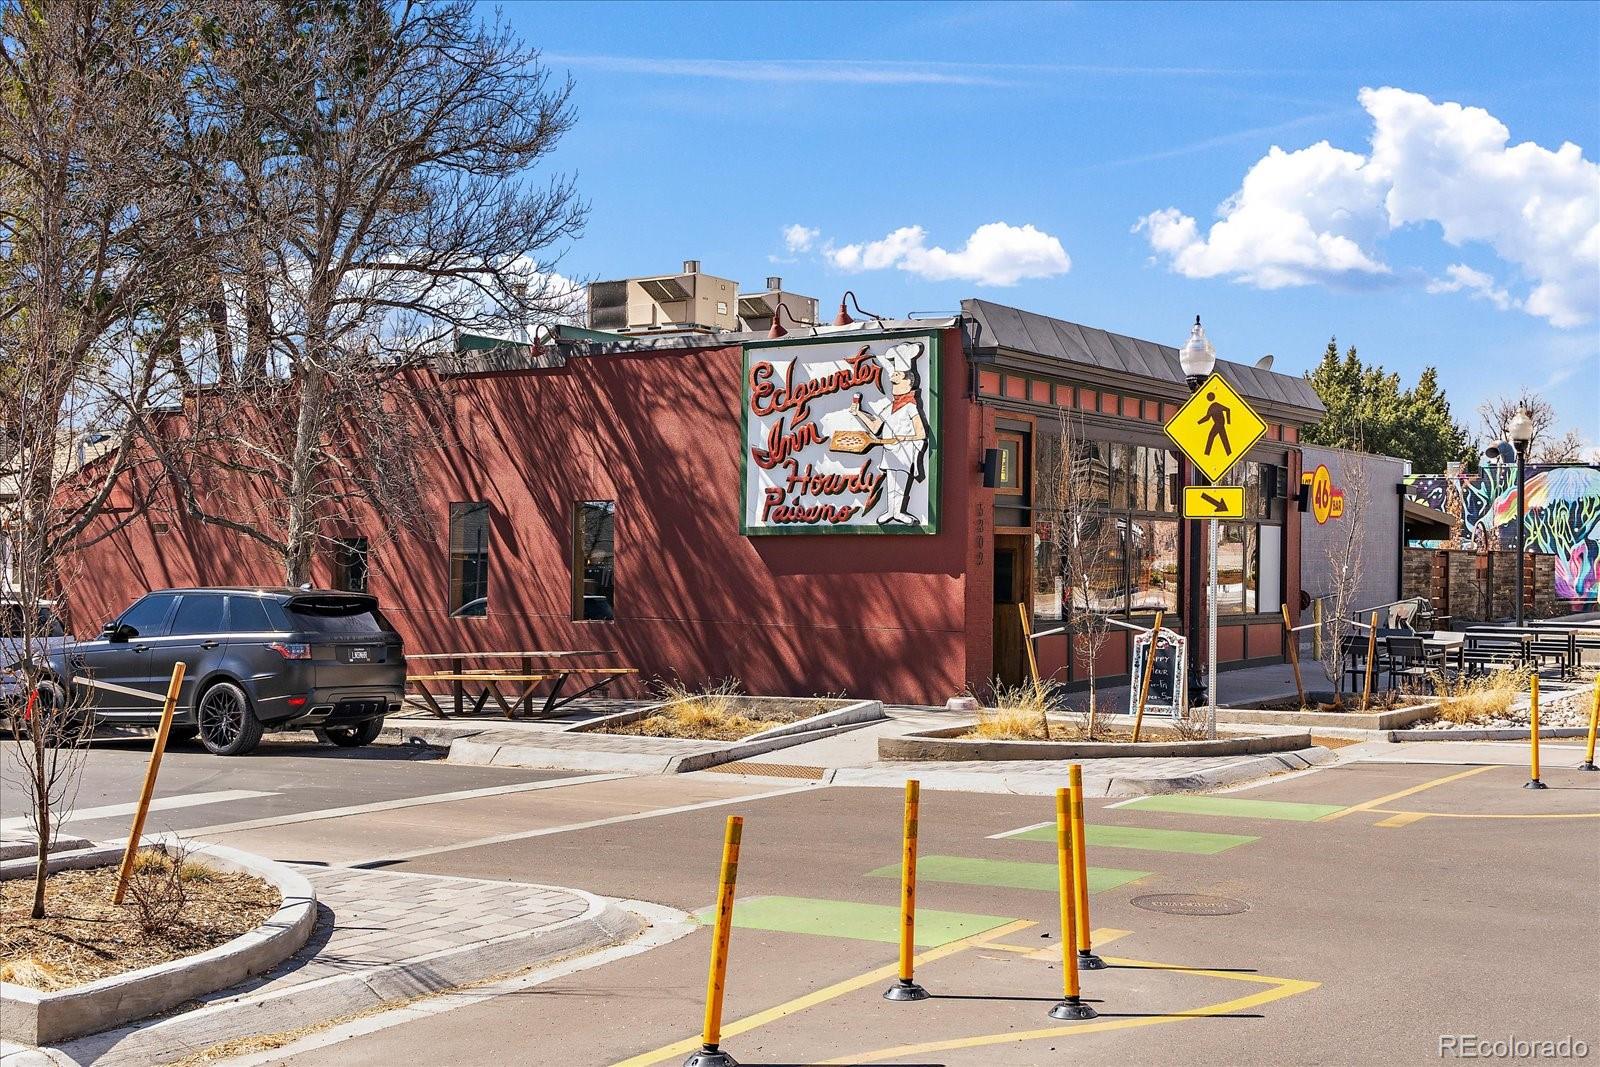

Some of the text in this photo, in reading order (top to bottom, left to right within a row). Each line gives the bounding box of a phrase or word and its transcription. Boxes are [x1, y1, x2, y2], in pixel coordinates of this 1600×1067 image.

[749, 345, 885, 430] Edgewater
[751, 417, 829, 470] Inn
[761, 486, 863, 524] Paisano
[783, 458, 887, 518] Howdy
[1315, 480, 1329, 509] 46
